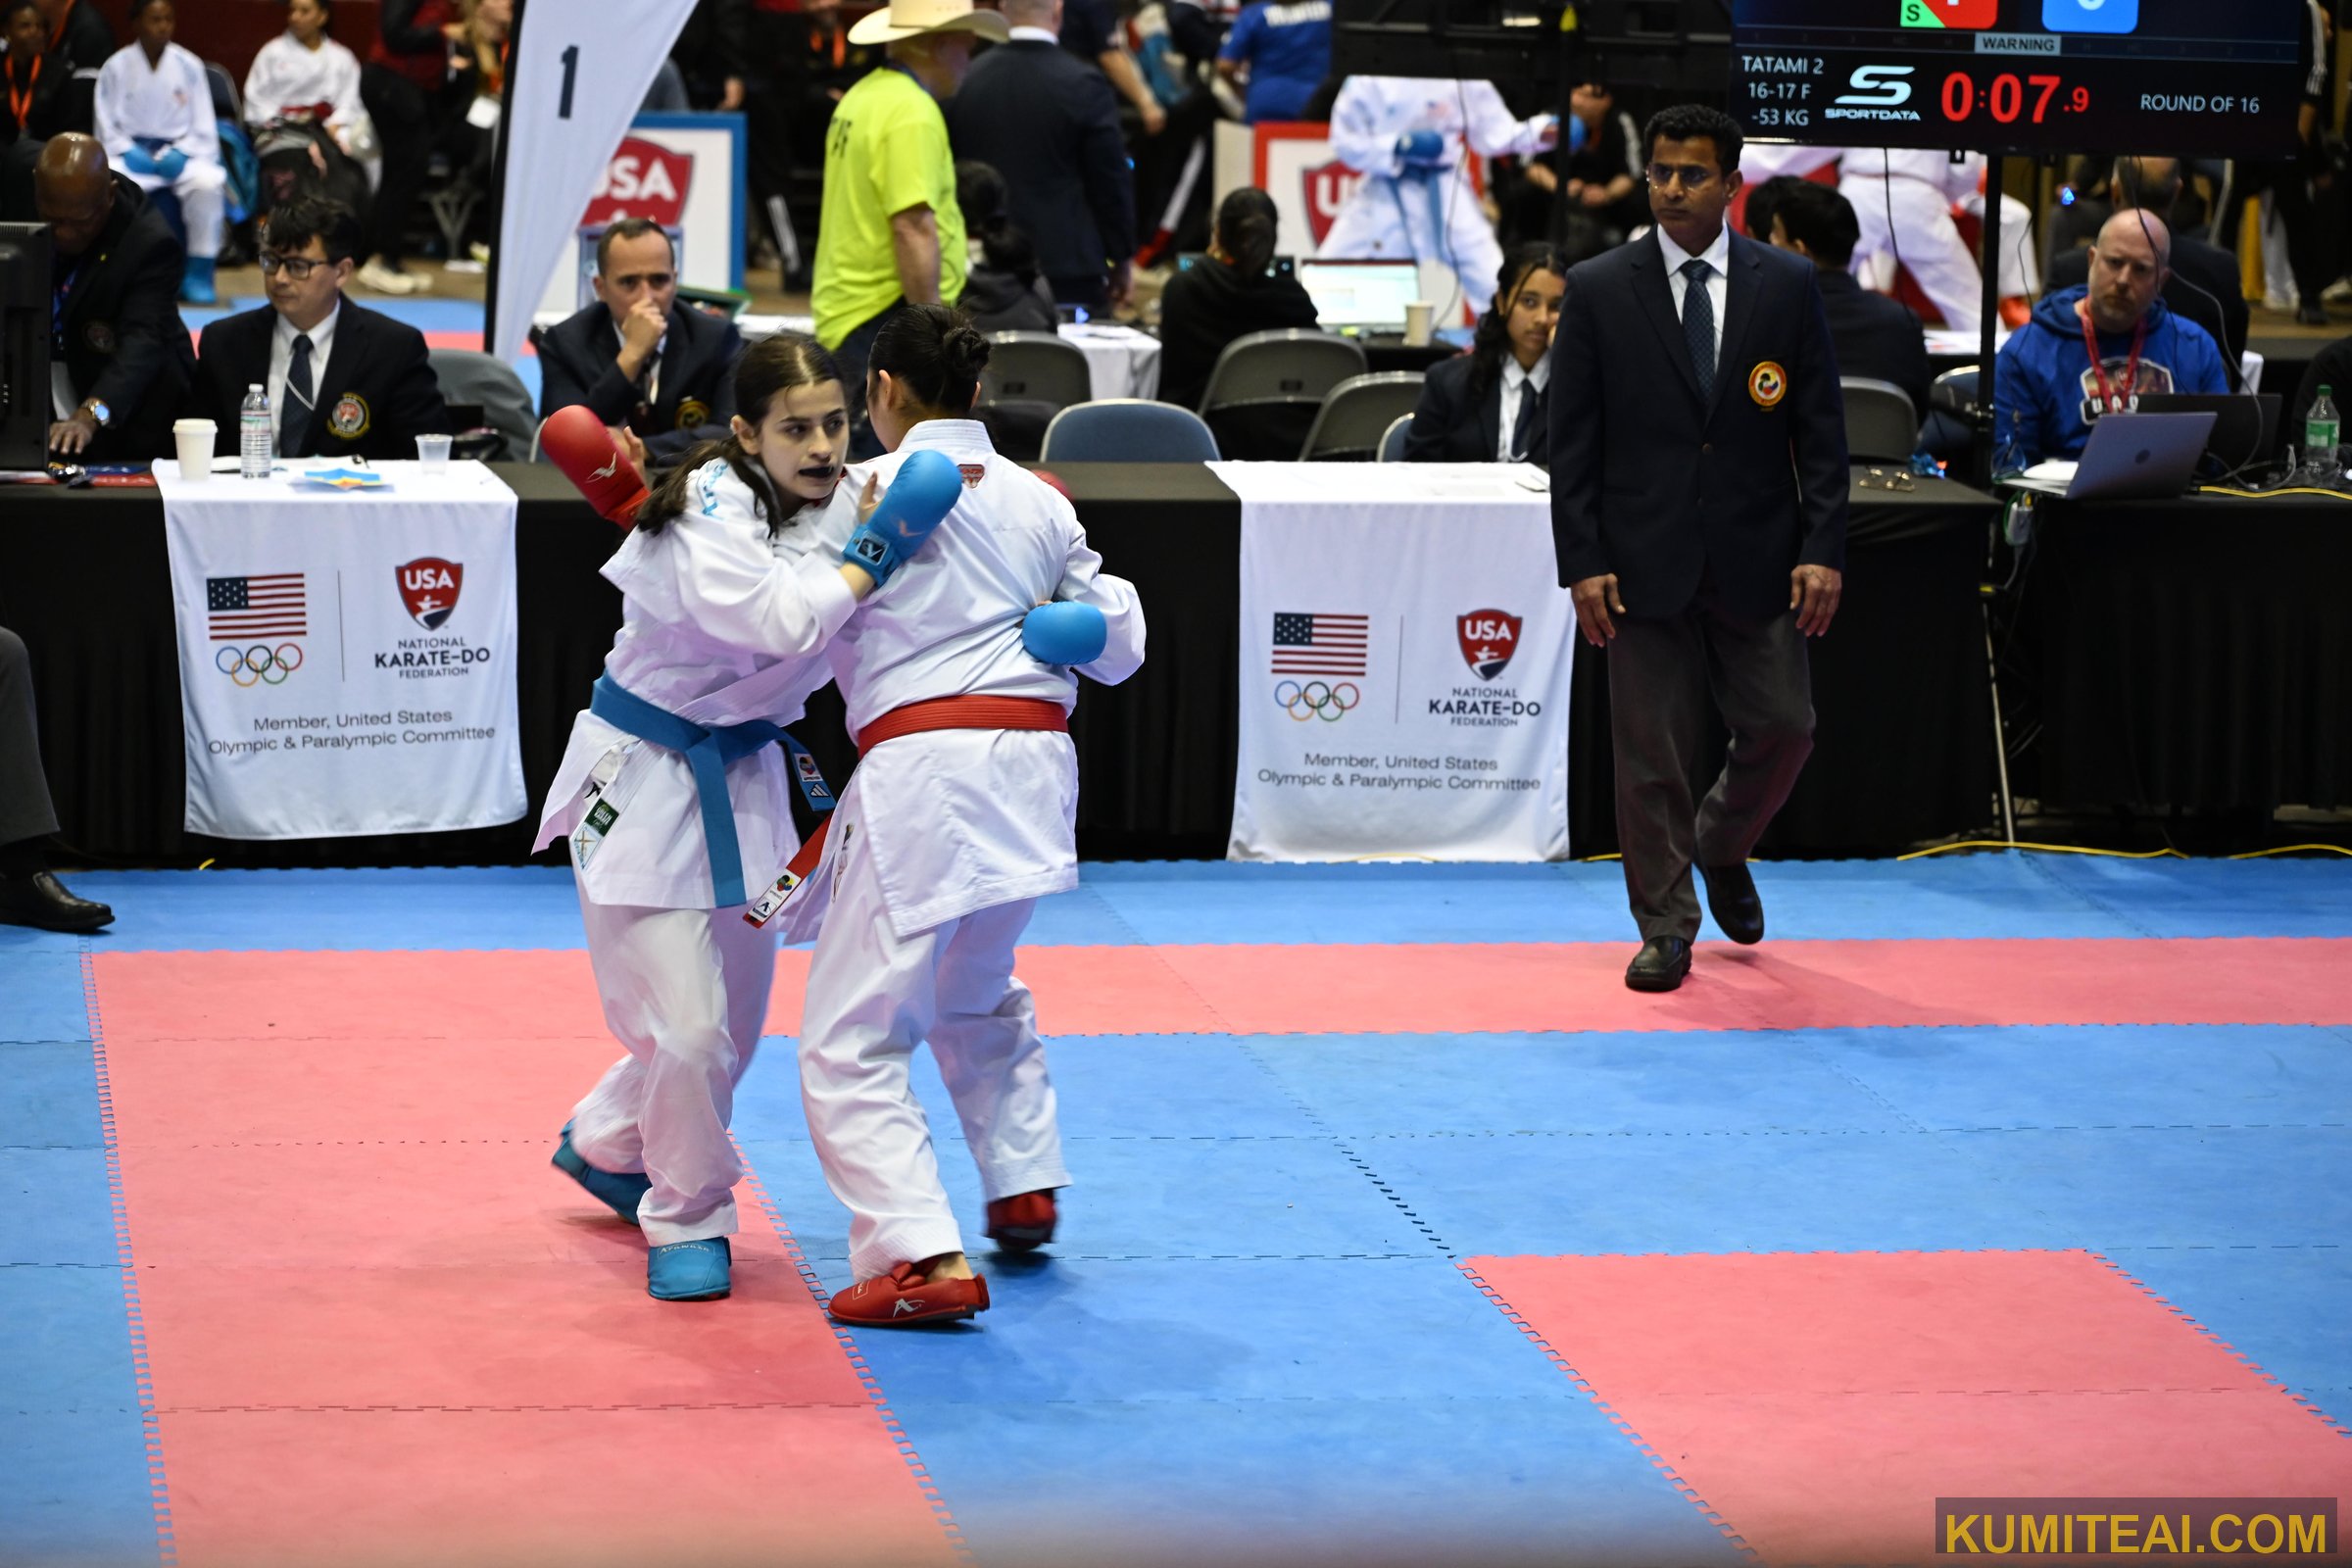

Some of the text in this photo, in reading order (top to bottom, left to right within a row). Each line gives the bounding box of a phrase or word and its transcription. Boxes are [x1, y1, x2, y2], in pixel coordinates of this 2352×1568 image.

[1906, 4, 1920, 22] S
[1982, 37, 2055, 52] WARNING
[1741, 55, 1824, 74] TATAMI 2
[558, 44, 579, 120] 1
[1748, 82, 1811, 99] 16-17 F
[2140, 94, 2260, 114] ROUND OF 16
[1751, 108, 1809, 126] -53 KG
[1825, 108, 1921, 122] SPORTDATA
[404, 568, 455, 591] USA
[1464, 619, 1513, 642] USA
[398, 637, 466, 650] NATIONAL
[374, 648, 490, 668] KARATE-DO
[399, 667, 468, 680] FEDERATION
[1452, 687, 1518, 699] NATIONAL
[1429, 699, 1542, 716] KARATE-DO
[254, 710, 453, 732] Member, United States
[1450, 716, 1518, 727] FEDERATION
[209, 726, 496, 756] Olympic & Paralympic Committee
[1304, 753, 1497, 771] Member, United States
[1257, 769, 1541, 791] Olympic & Paralympic Committee
